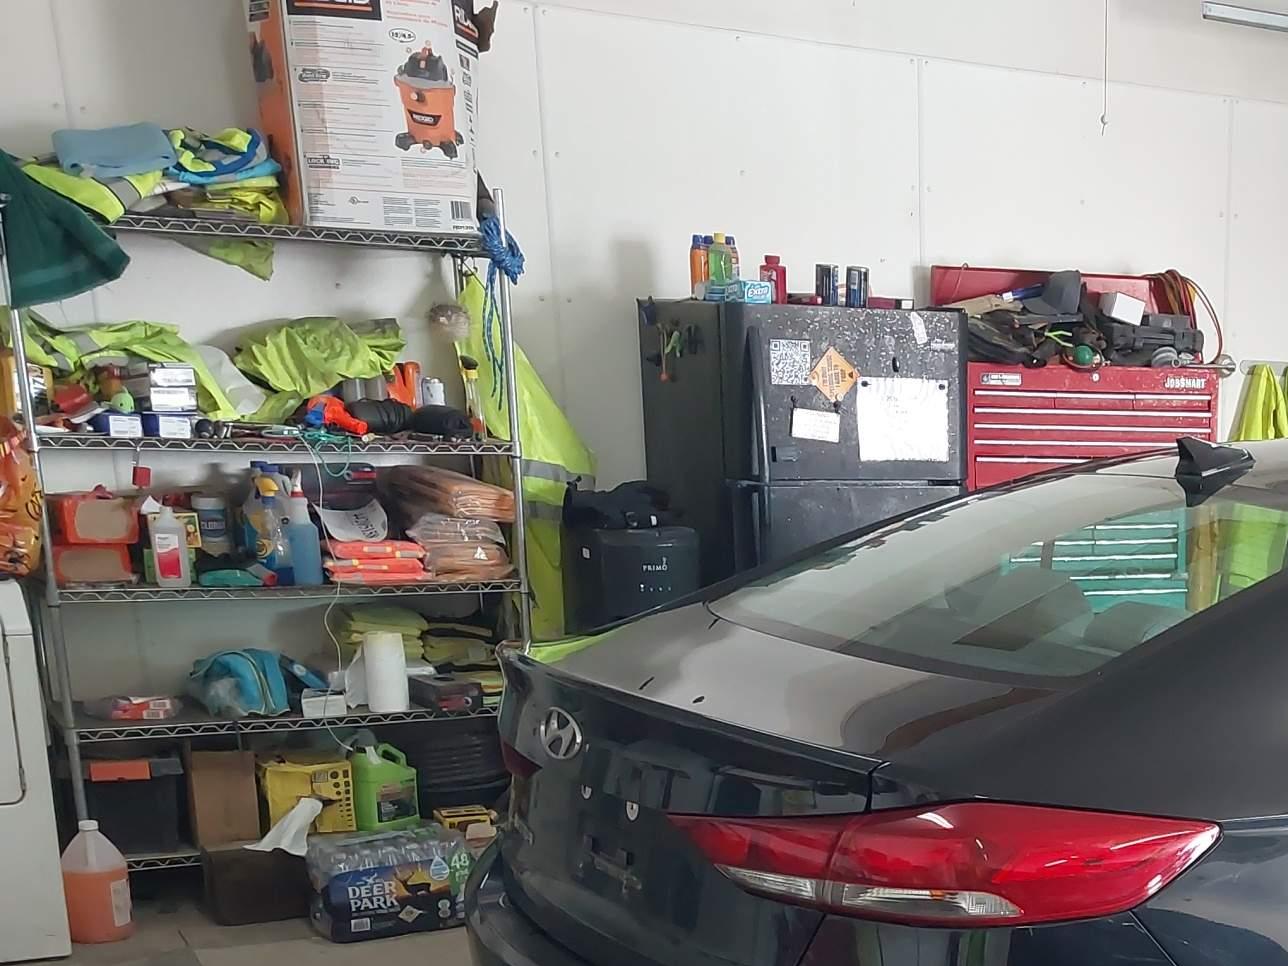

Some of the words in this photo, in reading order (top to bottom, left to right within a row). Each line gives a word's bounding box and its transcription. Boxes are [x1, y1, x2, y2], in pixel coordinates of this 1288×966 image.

[451, 853, 470, 869] 48
[348, 881, 396, 899] DEER
[350, 895, 399, 912] PARK
